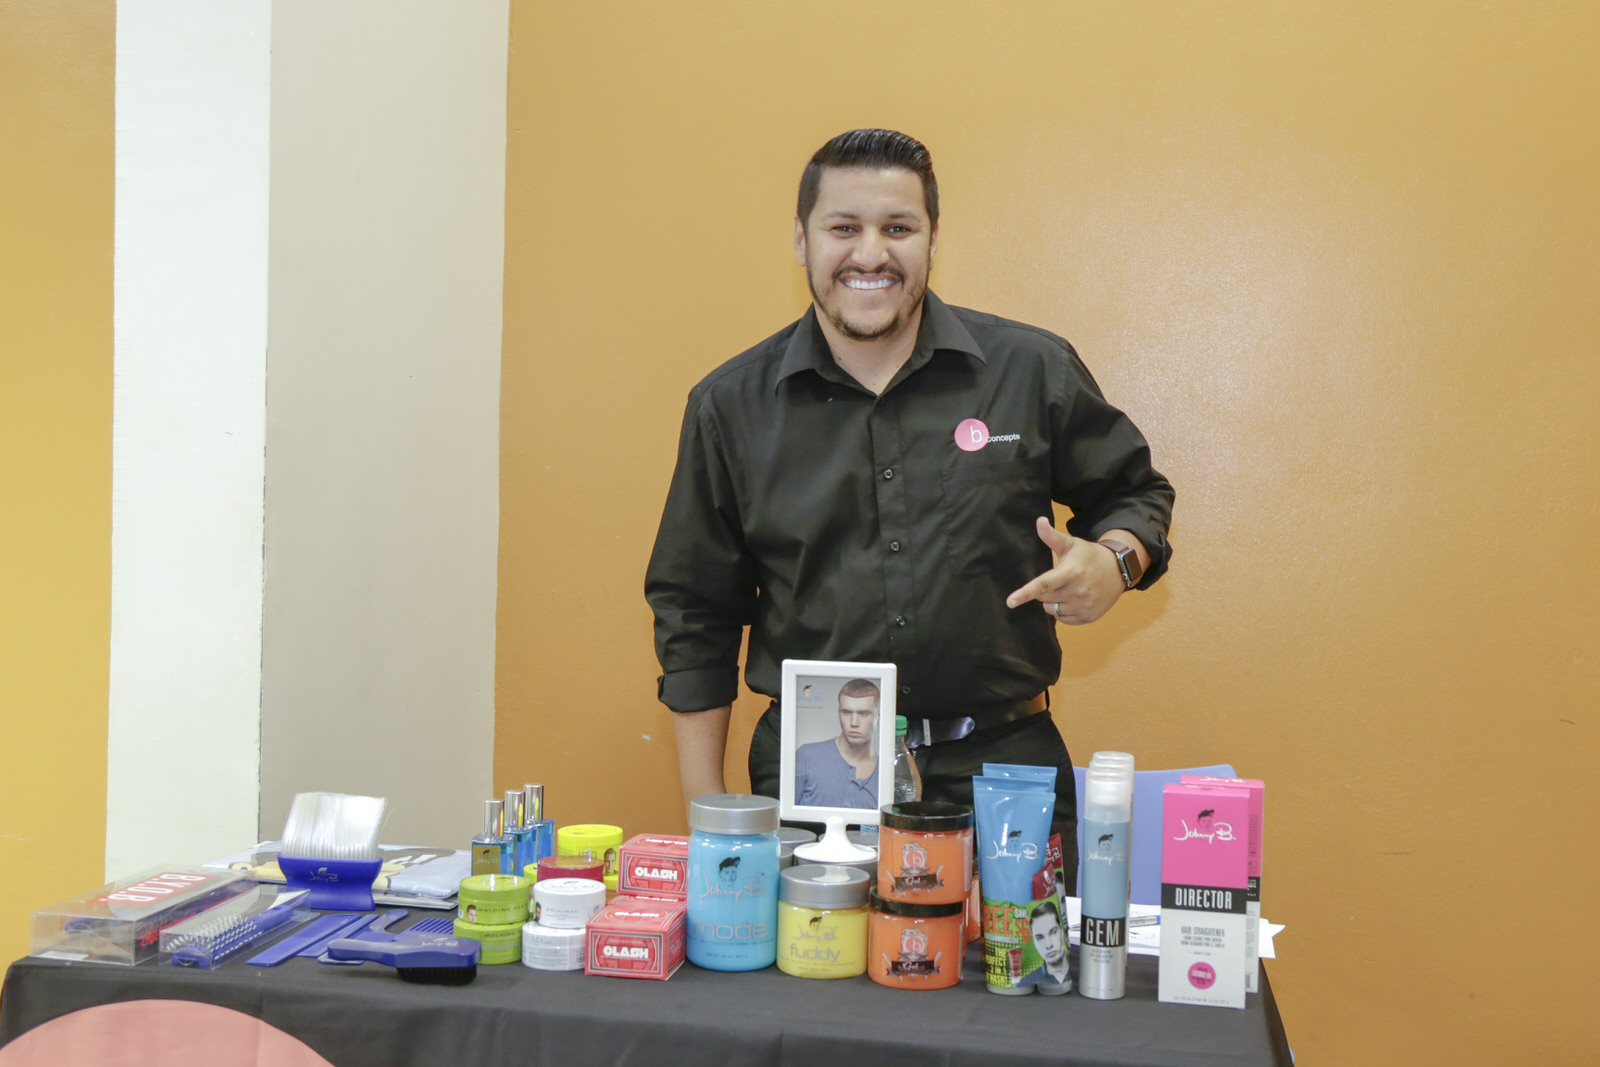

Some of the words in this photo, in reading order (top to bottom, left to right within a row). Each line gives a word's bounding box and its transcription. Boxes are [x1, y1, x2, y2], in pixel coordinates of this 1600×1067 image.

[985, 433, 1021, 443] concepts
[1173, 819, 1215, 844] Johnny
[986, 839, 1022, 863] Johnny
[695, 871, 742, 903] Johnny
[1175, 887, 1232, 910] DIRECTOR
[693, 920, 768, 940] mode
[1085, 918, 1120, 946] GEM
[790, 943, 841, 964] fuddy
